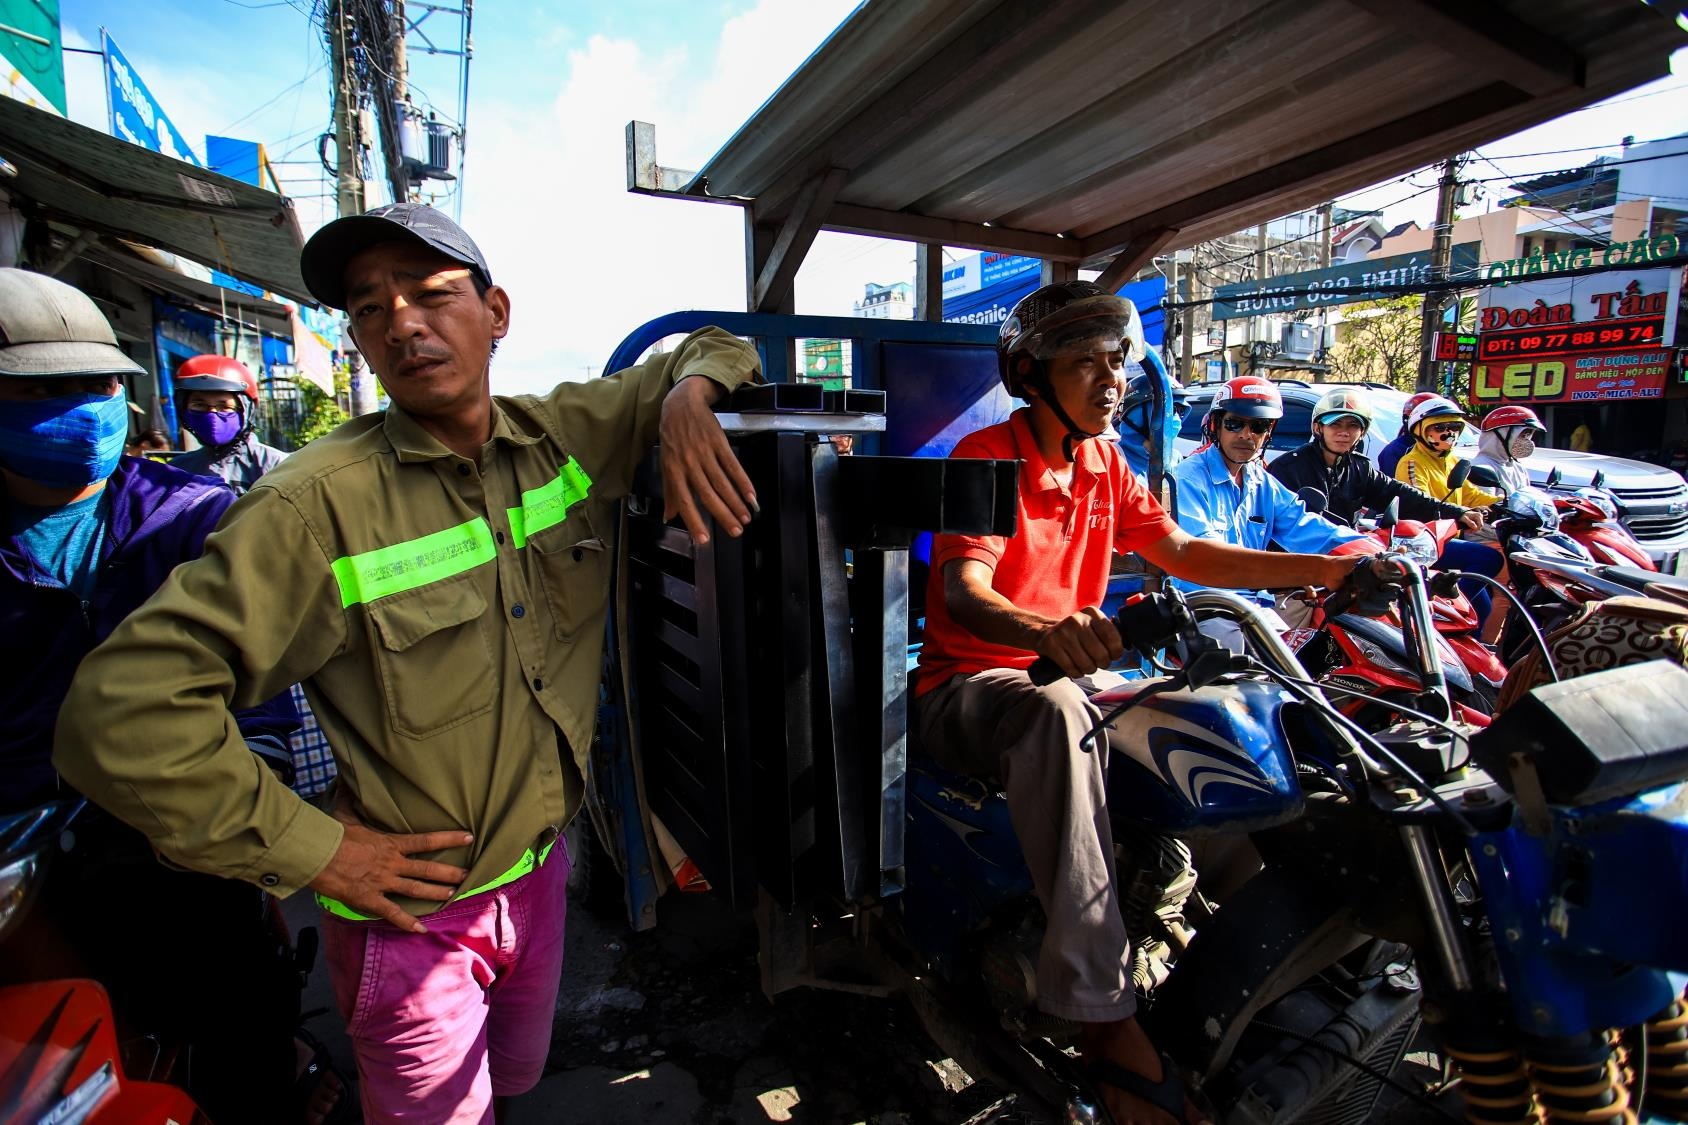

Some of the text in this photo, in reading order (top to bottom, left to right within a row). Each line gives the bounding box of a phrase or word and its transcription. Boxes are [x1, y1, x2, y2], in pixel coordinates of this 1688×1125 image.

[1488, 230, 1680, 287] QUẢNG CÁO
[1480, 279, 1668, 331] Đoàn Tấn
[1487, 339, 1515, 353] ĐT:
[1519, 335, 1541, 350] 09
[1544, 334, 1569, 348] 77
[1571, 331, 1595, 345] 88
[1600, 328, 1625, 342] 99
[1629, 326, 1655, 341] 74
[1475, 361, 1566, 398] LED
[1571, 390, 1599, 400] INOX
[1604, 388, 1633, 399] MICA
[1638, 387, 1662, 398] ALU
[1333, 677, 1365, 690] HONDA
